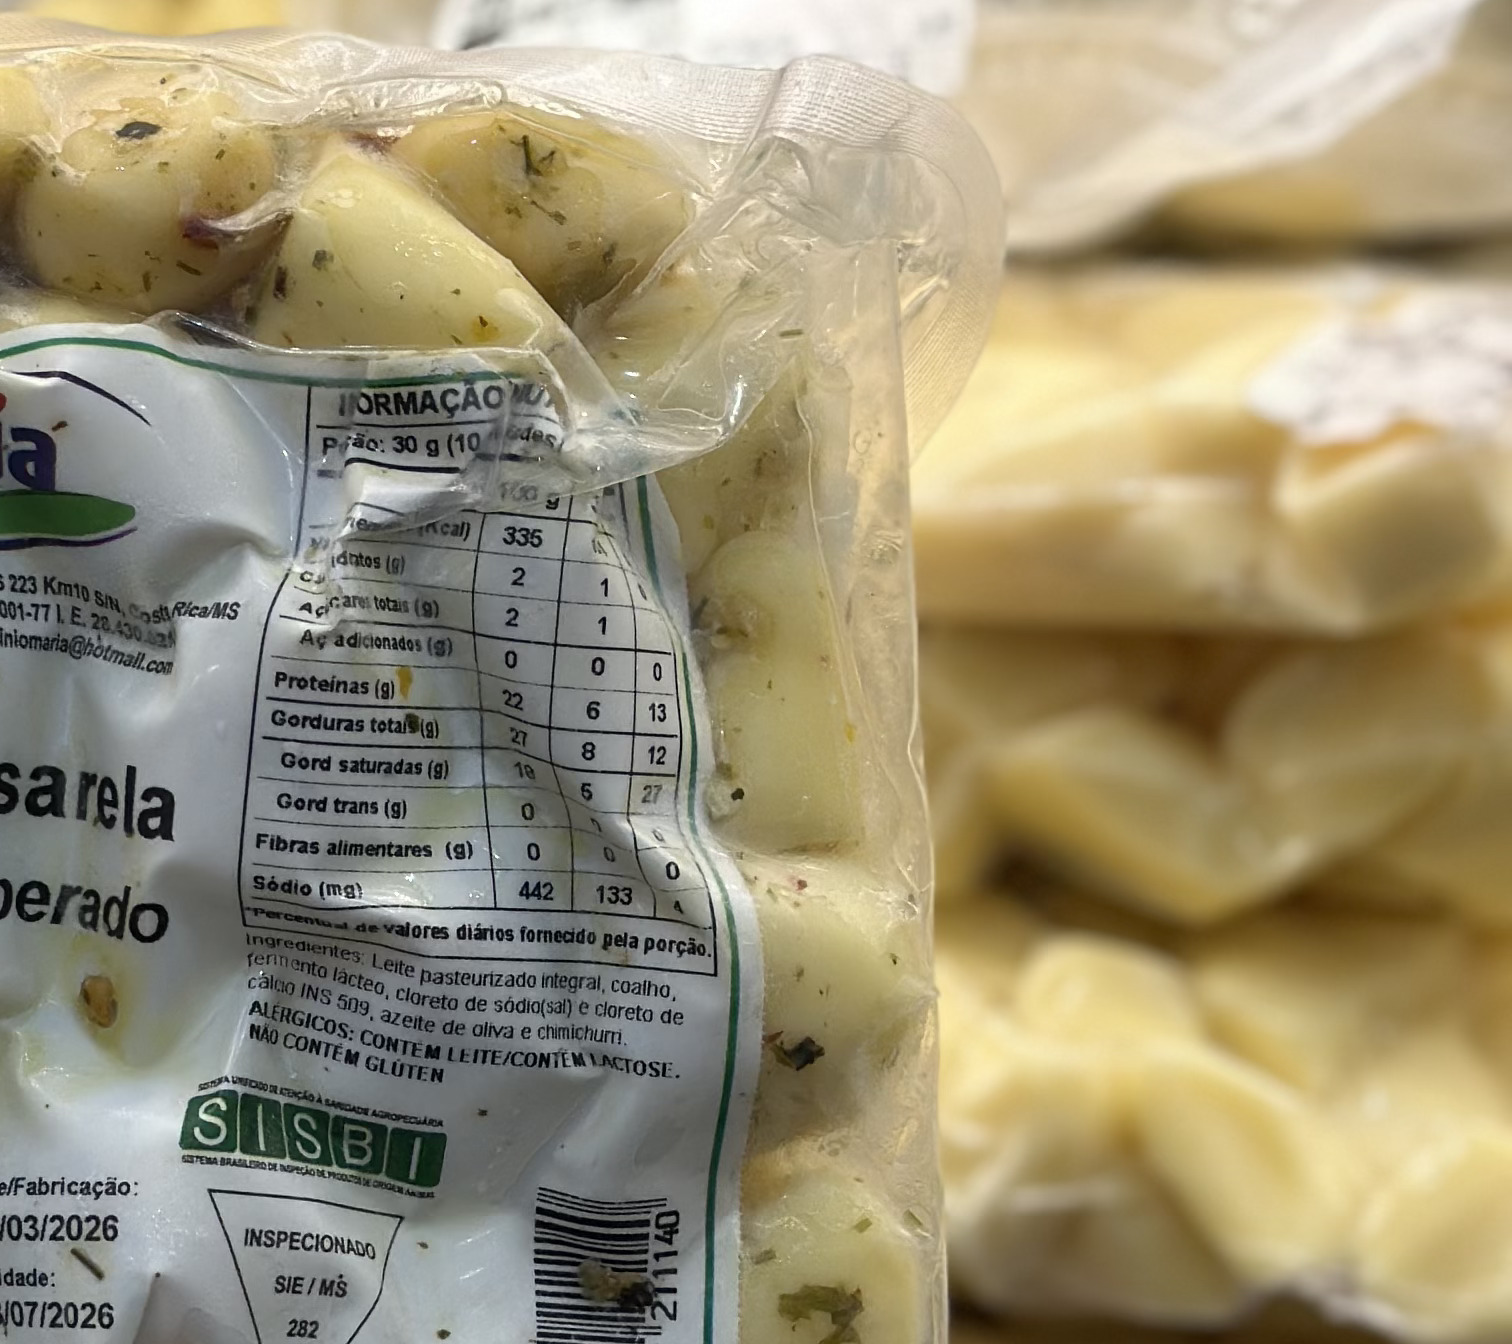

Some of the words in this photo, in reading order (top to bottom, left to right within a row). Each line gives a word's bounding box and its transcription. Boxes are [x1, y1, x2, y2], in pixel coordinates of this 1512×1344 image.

[392, 435, 418, 454] 30
[426, 439, 440, 457] g
[502, 526, 544, 548] 335
[7, 574, 38, 595] 223
[43, 575, 90, 603] Km10
[172, 600, 242, 621] Rica/MS
[511, 567, 526, 586] 2
[600, 577, 610, 597] 1
[505, 607, 520, 627] 2
[597, 616, 607, 635] 1
[427, 636, 454, 657] (g)
[504, 650, 518, 669] 0
[591, 657, 605, 676] 0
[653, 662, 662, 682] 0
[274, 671, 370, 695] Proteínas
[374, 678, 395, 700] (g)
[502, 689, 524, 711] 22
[586, 701, 601, 720] 6
[648, 702, 667, 723] 13
[270, 709, 365, 733] Gorduras
[420, 718, 440, 739] (g)
[509, 725, 529, 748] 27
[581, 741, 596, 761] 8
[647, 745, 667, 766] 12
[280, 752, 331, 772] Gord
[338, 756, 423, 776] saturadas
[427, 759, 450, 781] (g)
[580, 782, 594, 801] 5
[641, 784, 664, 805] 27
[276, 792, 328, 813] Gord
[333, 797, 379, 815] trans
[384, 798, 408, 820] (g)
[521, 802, 535, 821] 0
[255, 832, 320, 855] Fibras
[326, 839, 433, 859] alimentares
[445, 841, 474, 861] (g)
[526, 842, 541, 861] 0
[603, 846, 616, 863] 0
[665, 860, 681, 881] 0
[252, 874, 312, 897] Sódio
[319, 881, 363, 901] (mg)
[519, 881, 555, 902] 442
[596, 885, 633, 906] 133
[354, 921, 379, 934] de
[383, 921, 450, 941] valores
[456, 922, 516, 943] diários
[519, 924, 597, 945] fornecido
[601, 930, 639, 951] pela
[642, 936, 712, 958] porção.
[245, 932, 365, 966] Ingredientes:
[372, 953, 416, 979] Leite
[419, 966, 537, 990] pasteurizado
[540, 972, 606, 994] integral,
[611, 978, 677, 1002] coalho,
[300, 982, 333, 1007] INS
[379, 1007, 436, 1034] azeite
[441, 1019, 466, 1037] de
[471, 1021, 515, 1040] oliva
[520, 1026, 532, 1040] e
[333, 962, 390, 1001] lácteo,
[395, 987, 459, 1012] cloreto
[464, 995, 488, 1013] de
[493, 998, 573, 1019] sódio(sal)
[578, 1000, 590, 1015] e
[594, 1001, 654, 1024] cloreto
[659, 1008, 685, 1026] de
[248, 999, 356, 1042] ALÉRGICOS:
[359, 1028, 442, 1061] CONTÉM
[249, 1022, 279, 1046] NÃO
[283, 1031, 361, 1068] CONTÉM
[364, 1057, 445, 1085] GLÚTEN
[193, 1097, 424, 1182] SISBI
[243, 1227, 377, 1261] INSPECIONADO
[273, 1274, 305, 1296] SIE
[319, 1278, 348, 1299] MS
[286, 1318, 320, 1340] 282
